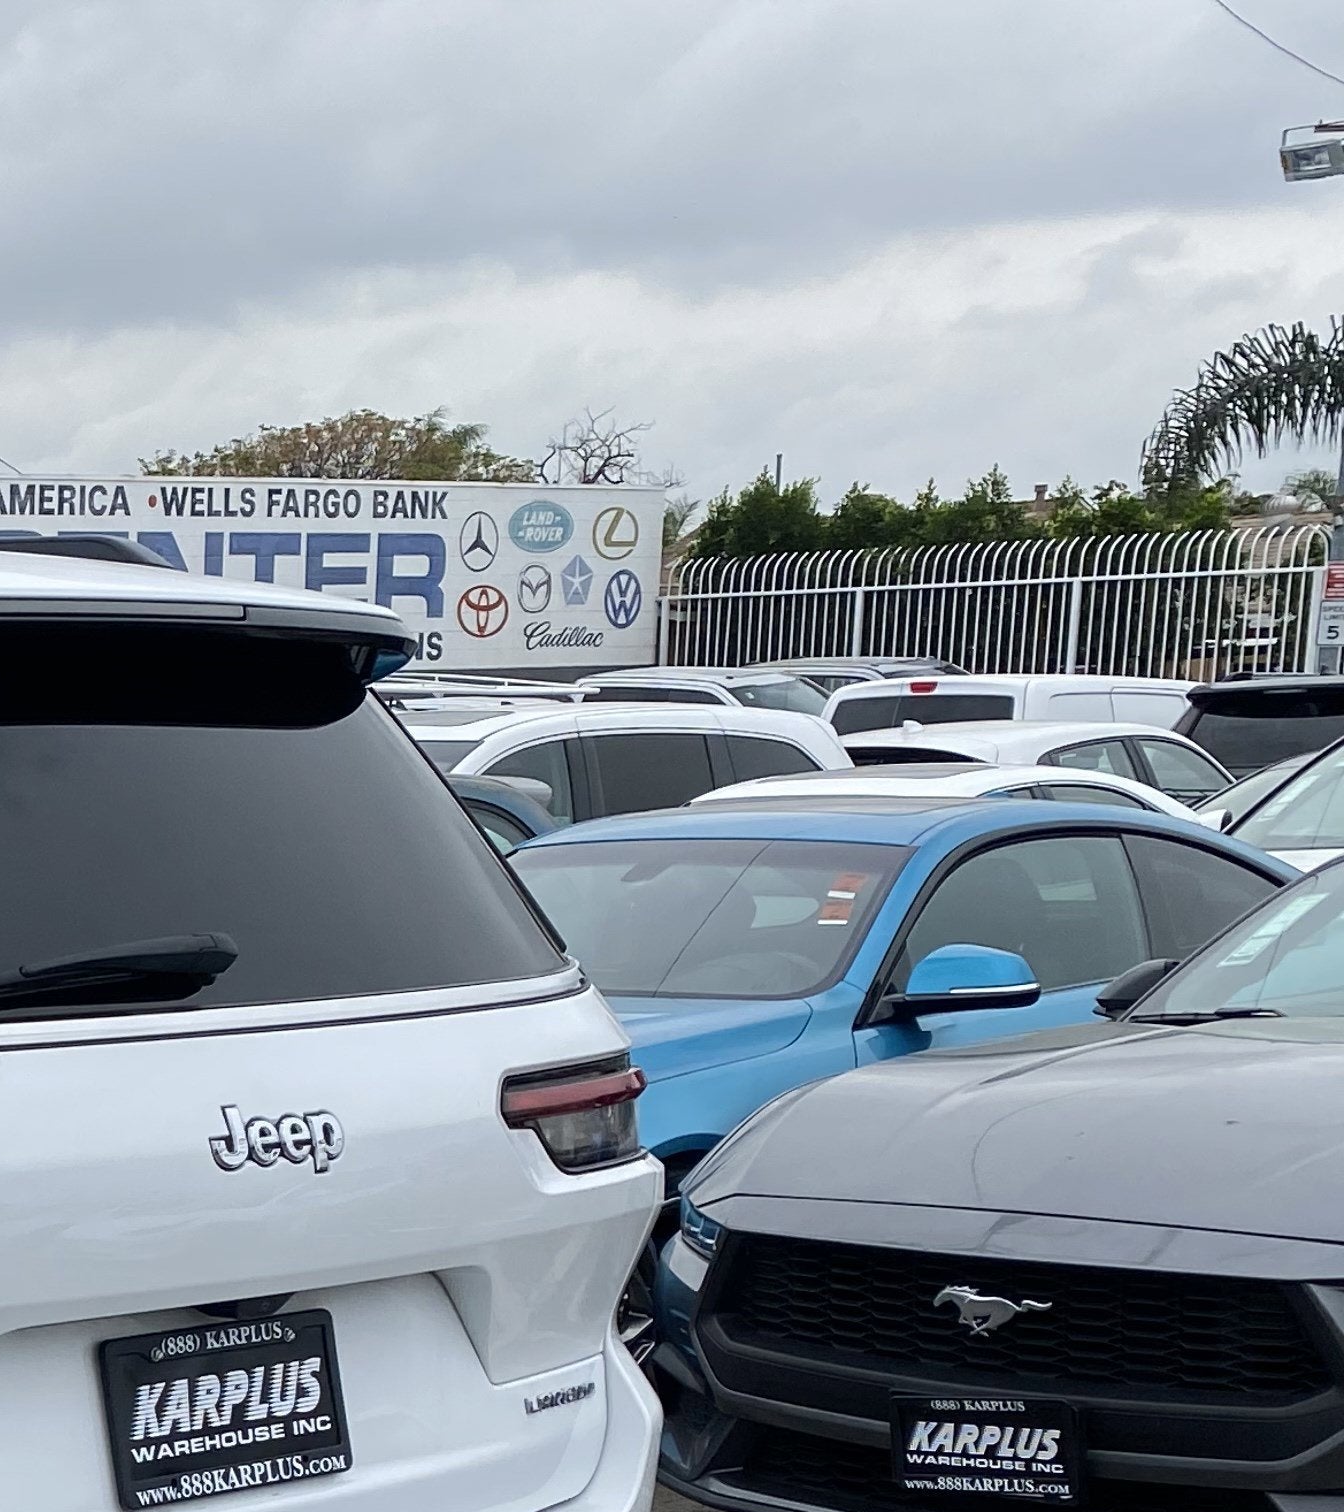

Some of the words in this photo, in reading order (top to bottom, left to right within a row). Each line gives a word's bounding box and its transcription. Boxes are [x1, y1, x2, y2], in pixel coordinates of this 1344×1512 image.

[160, 486, 256, 518] WELLS
[266, 488, 363, 519] FARGO
[372, 490, 449, 520] BANK
[524, 620, 604, 651] Cadillac
[209, 1103, 345, 1173] Jeep
[161, 1333, 201, 1355] (888)
[205, 1321, 282, 1350] KARPLUS
[129, 1357, 322, 1441] KARPLUS
[964, 1400, 1026, 1412] KARPLUS
[130, 1423, 286, 1464] WAREHOUSE
[293, 1416, 333, 1436] INC
[908, 1420, 1062, 1461] KARPLUS
[906, 1453, 1026, 1471] WAREHOUSE
[1031, 1463, 1065, 1474] INC
